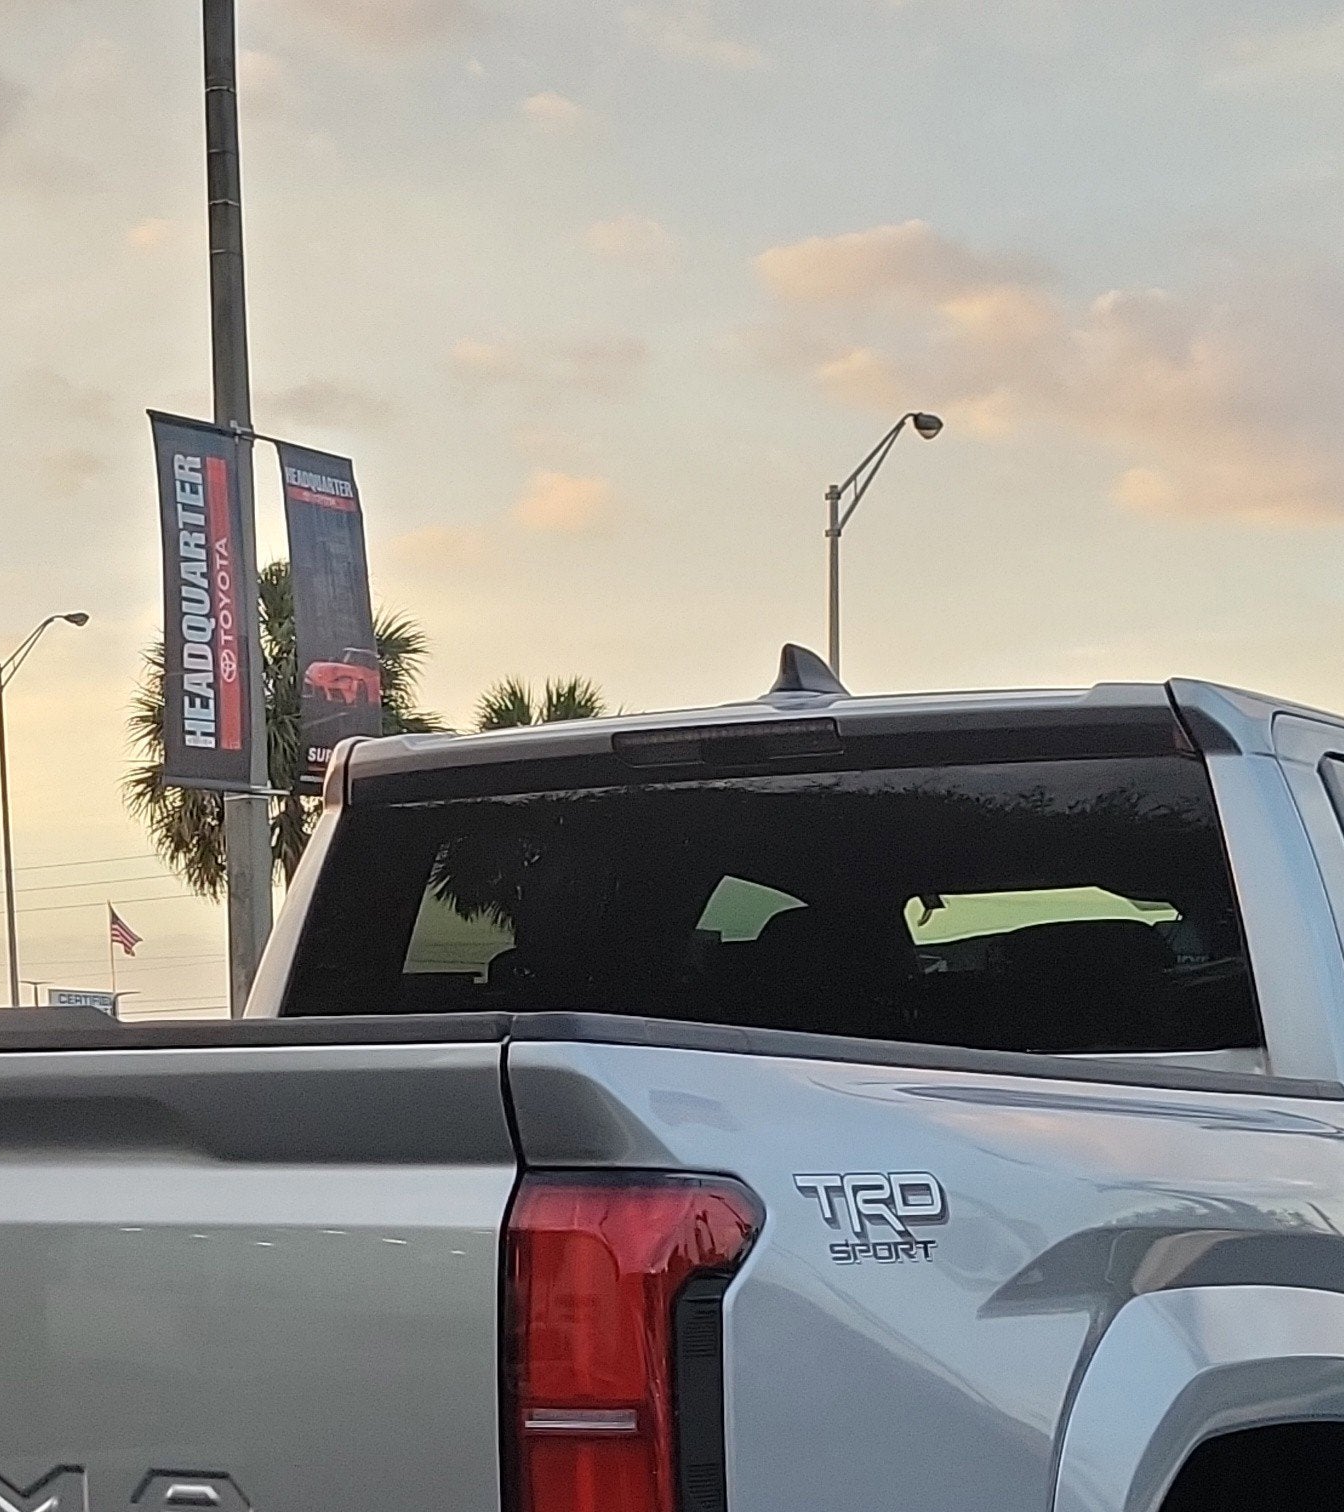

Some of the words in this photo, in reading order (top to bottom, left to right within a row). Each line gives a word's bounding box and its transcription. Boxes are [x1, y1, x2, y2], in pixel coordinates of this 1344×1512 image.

[285, 466, 354, 498] HEADQUARTER
[174, 453, 216, 749] HEADQUARTER
[215, 537, 234, 650] TOYOTA
[793, 1171, 949, 1241] TRD
[829, 1239, 937, 1265] SPORT
